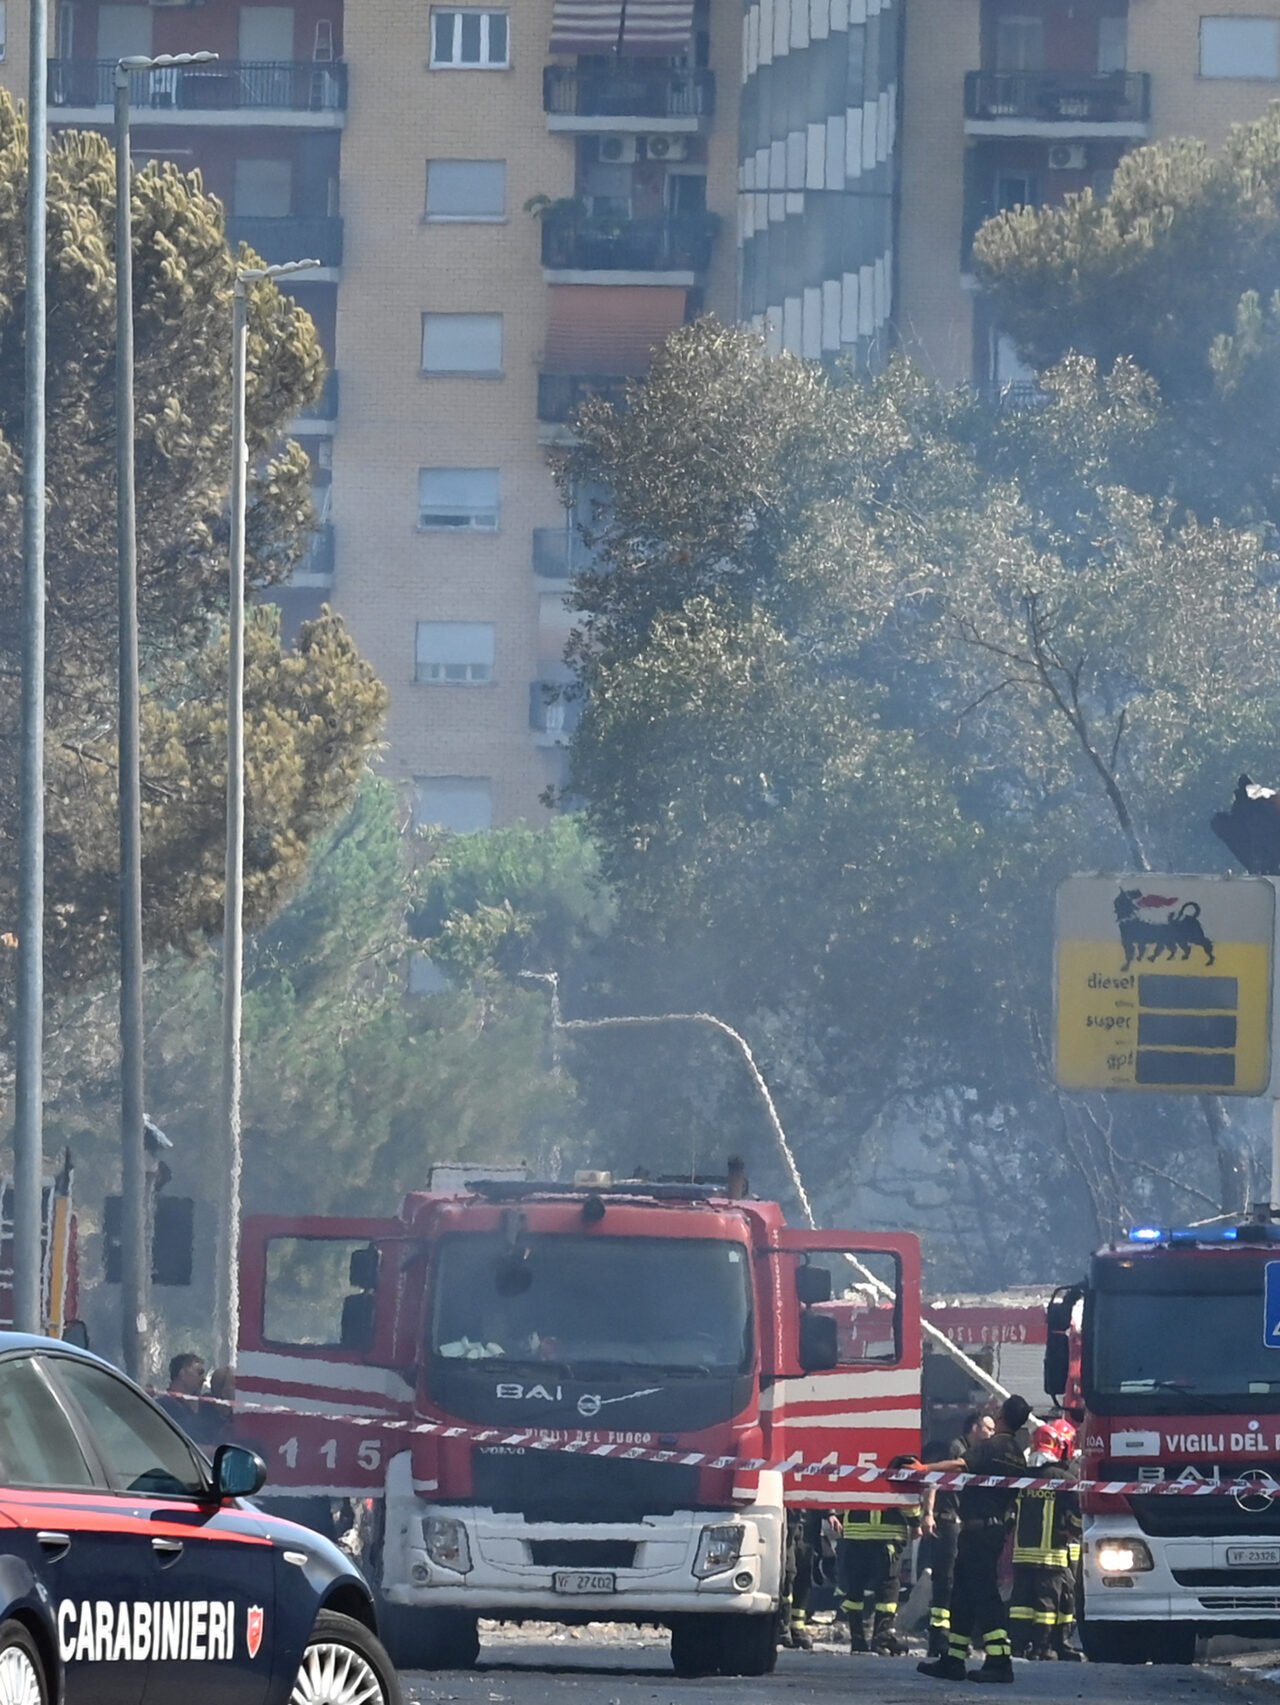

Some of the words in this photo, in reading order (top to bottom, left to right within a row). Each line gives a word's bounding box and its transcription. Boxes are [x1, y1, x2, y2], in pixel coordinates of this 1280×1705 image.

[1087, 972, 1135, 989] diesel
[1086, 1015, 1131, 1030] super
[496, 1383, 563, 1401] BAI
[576, 1430, 601, 1443] DEL
[608, 1431, 652, 1444] FUOCO
[1165, 1433, 1225, 1452] VIGILI
[1230, 1432, 1269, 1451] DEL
[278, 1436, 382, 1471] 115
[479, 1446, 526, 1455] VOLVO
[1138, 1465, 1221, 1485] BAI
[577, 1575, 612, 1589] 27402
[58, 1598, 235, 1662] CARABINIERI
